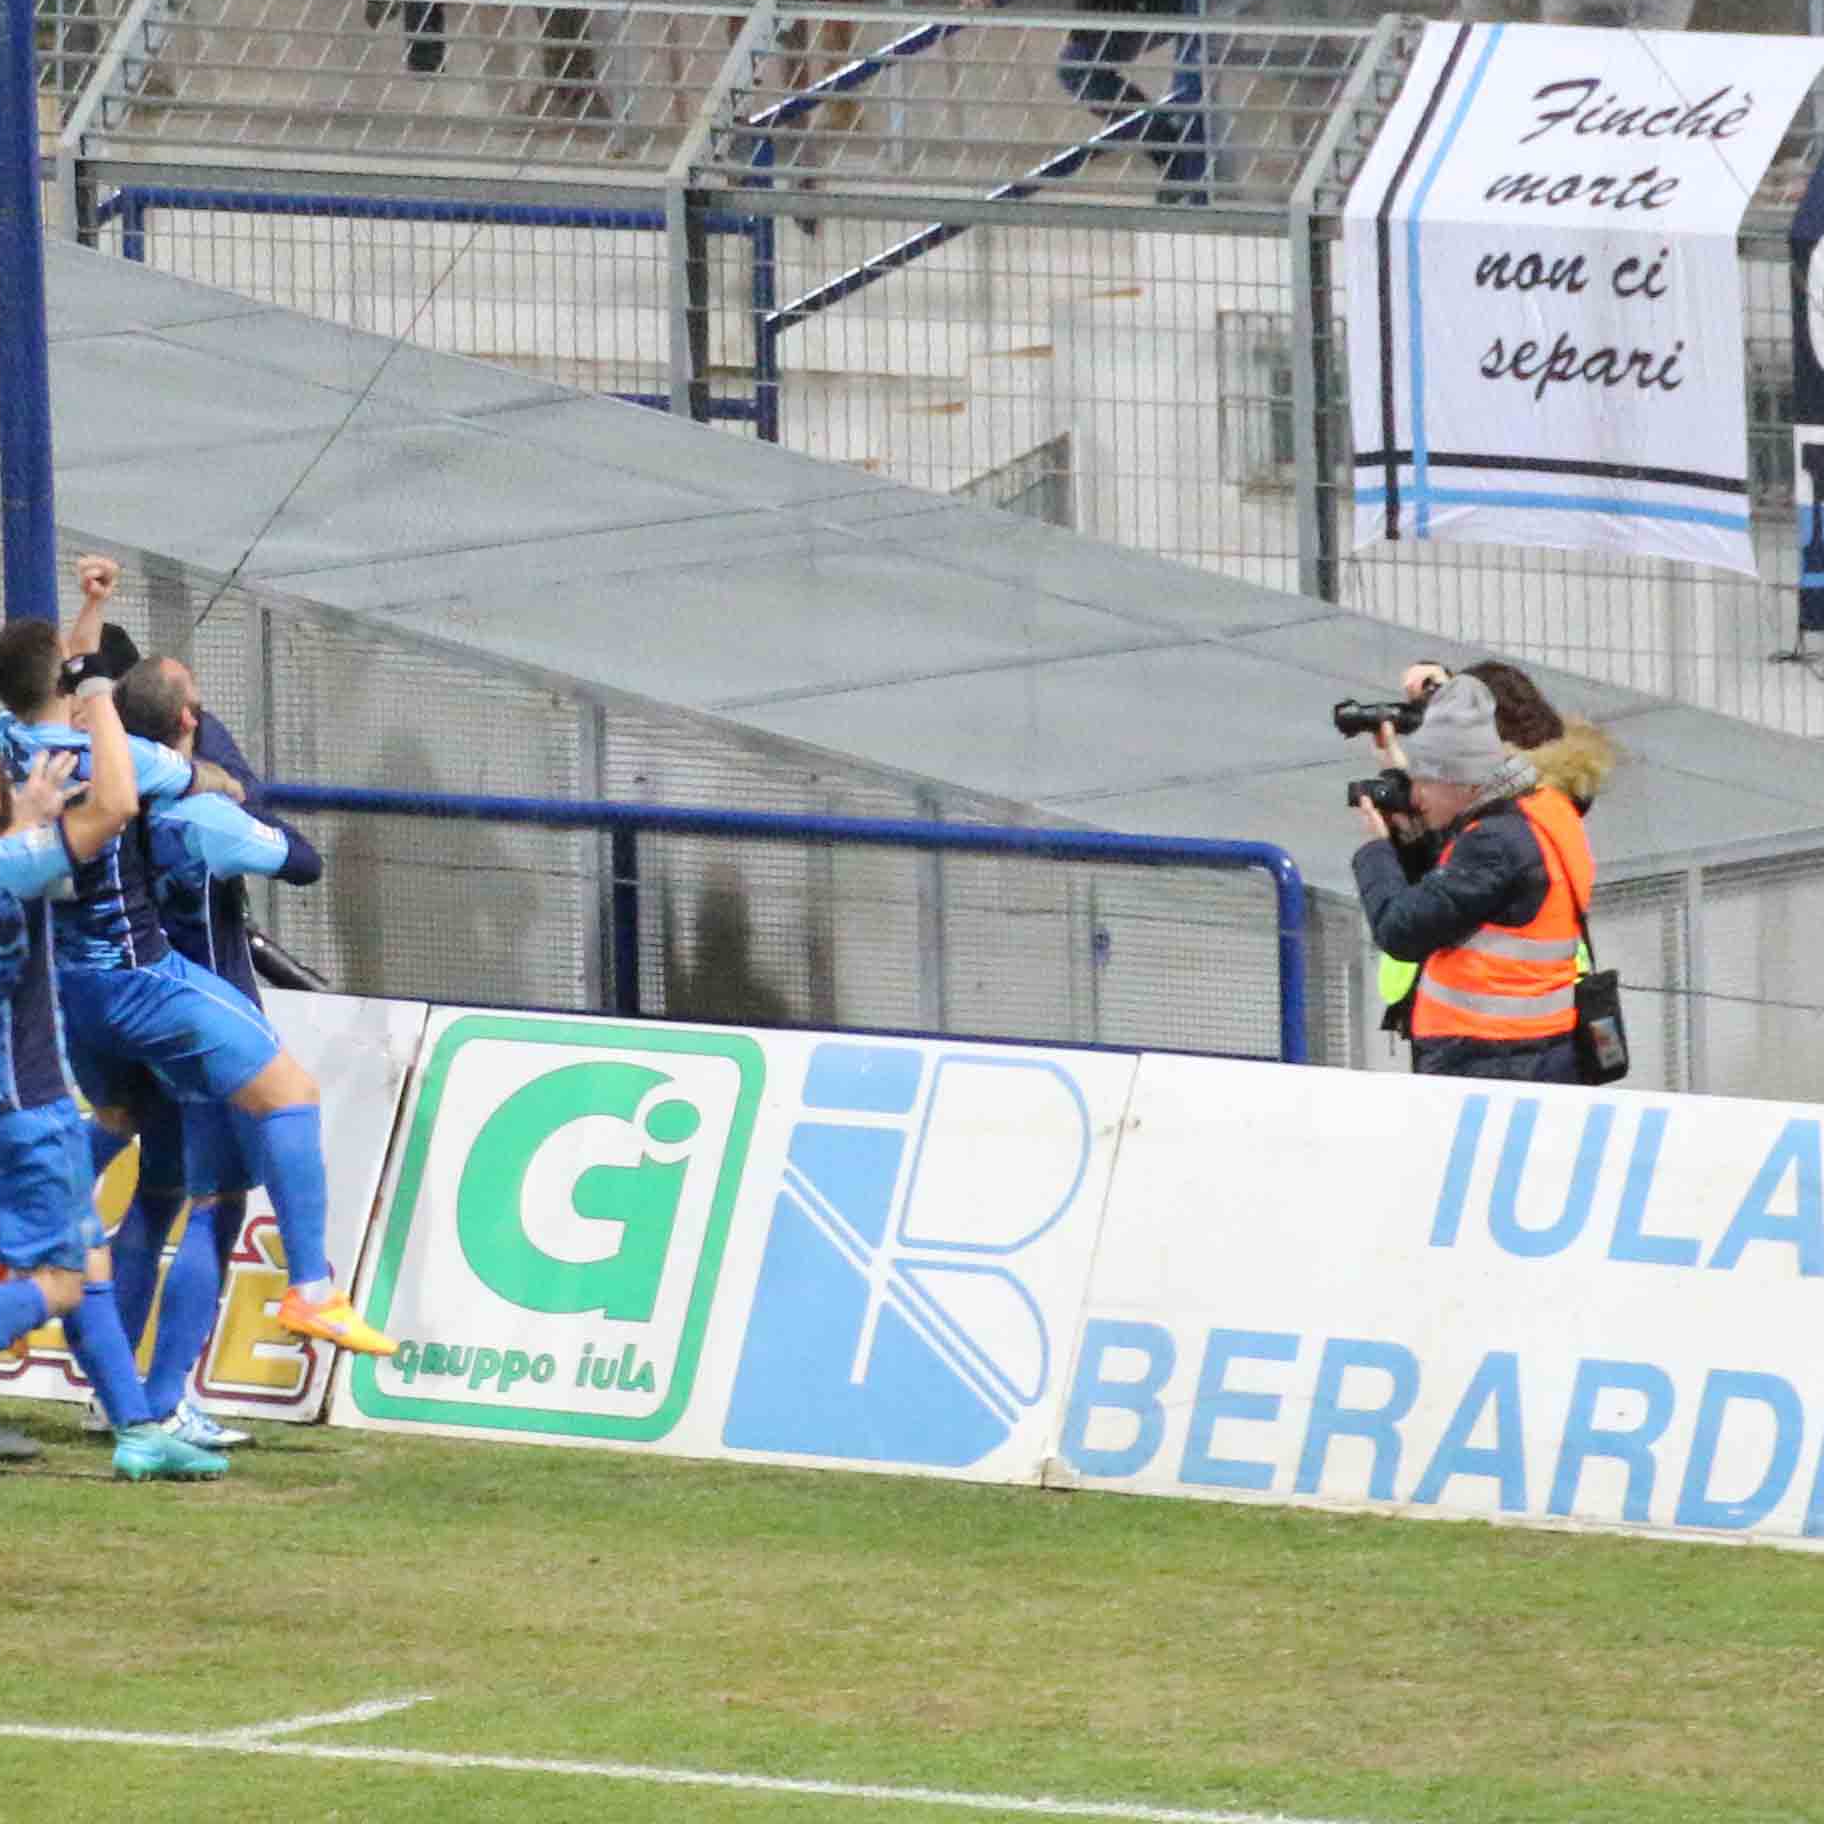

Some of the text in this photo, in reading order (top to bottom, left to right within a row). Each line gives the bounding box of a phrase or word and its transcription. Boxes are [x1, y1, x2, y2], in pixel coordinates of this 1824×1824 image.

[1484, 166, 1678, 212] morte
[1474, 246, 1670, 301] non ci
[1480, 337, 1686, 402] separi
